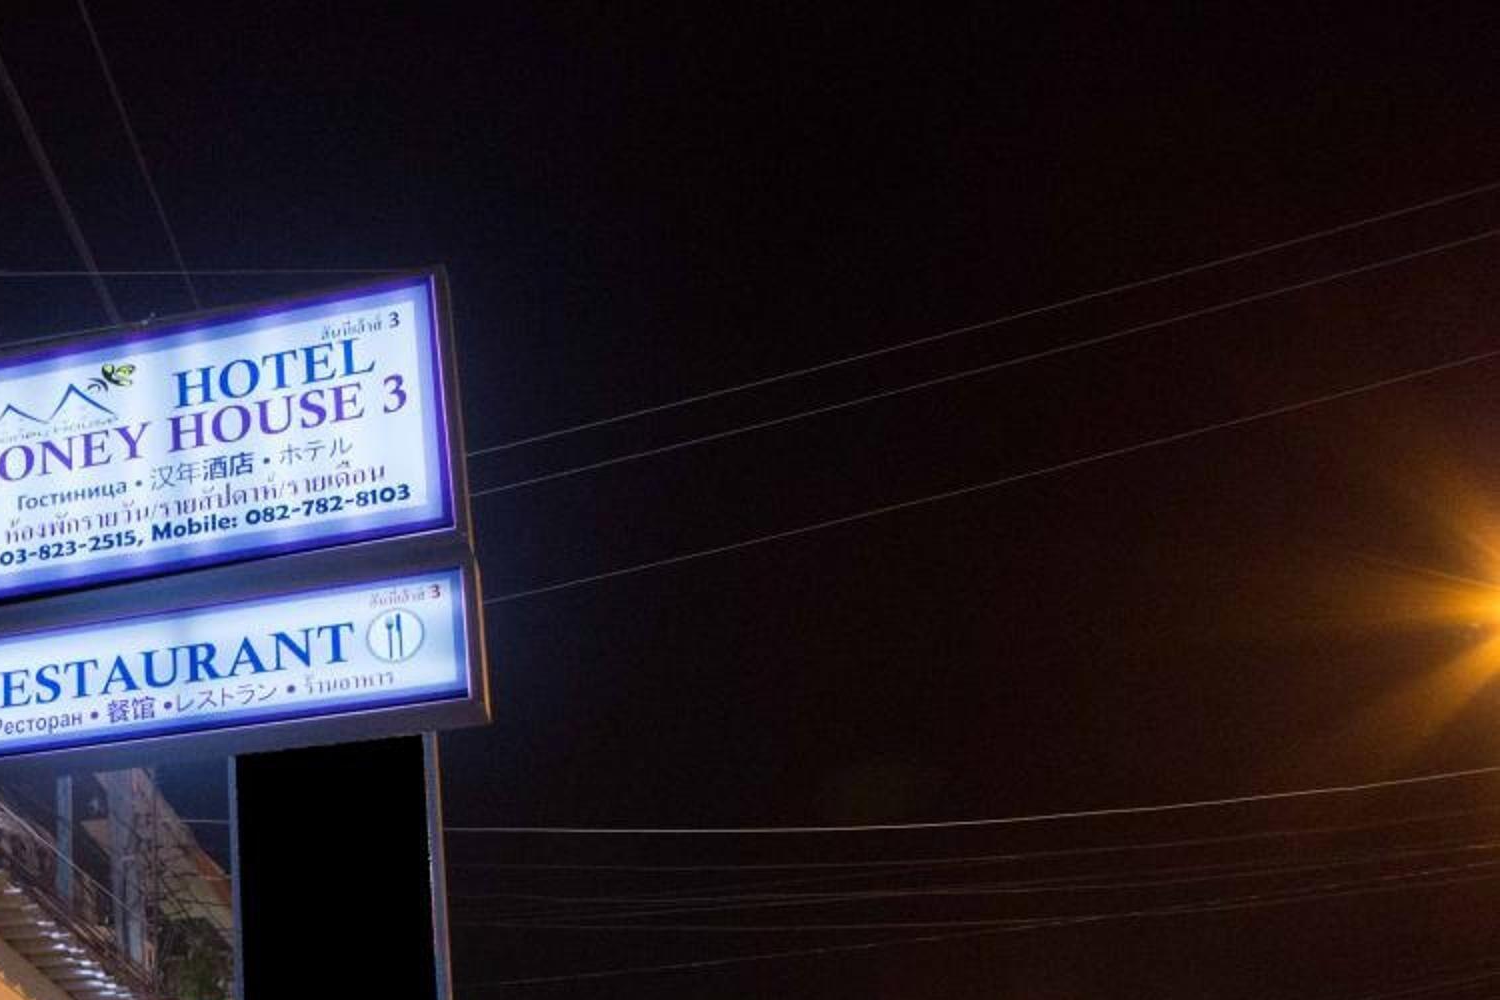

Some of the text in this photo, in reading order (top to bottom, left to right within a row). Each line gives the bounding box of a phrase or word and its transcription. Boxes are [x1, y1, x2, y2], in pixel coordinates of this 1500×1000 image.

[388, 311, 401, 328] 3
[172, 337, 376, 409] HOTEL
[166, 383, 365, 453] HOUSE
[383, 374, 407, 414] 3
[279, 437, 353, 465] ホテル
[17, 481, 127, 510] Гостиница
[0, 530, 144, 566] 03-823-2515,
[151, 514, 237, 542] Mobile:
[245, 483, 411, 525] 082-782-8103
[430, 584, 442, 599] 3
[177, 684, 277, 713] レストラン
